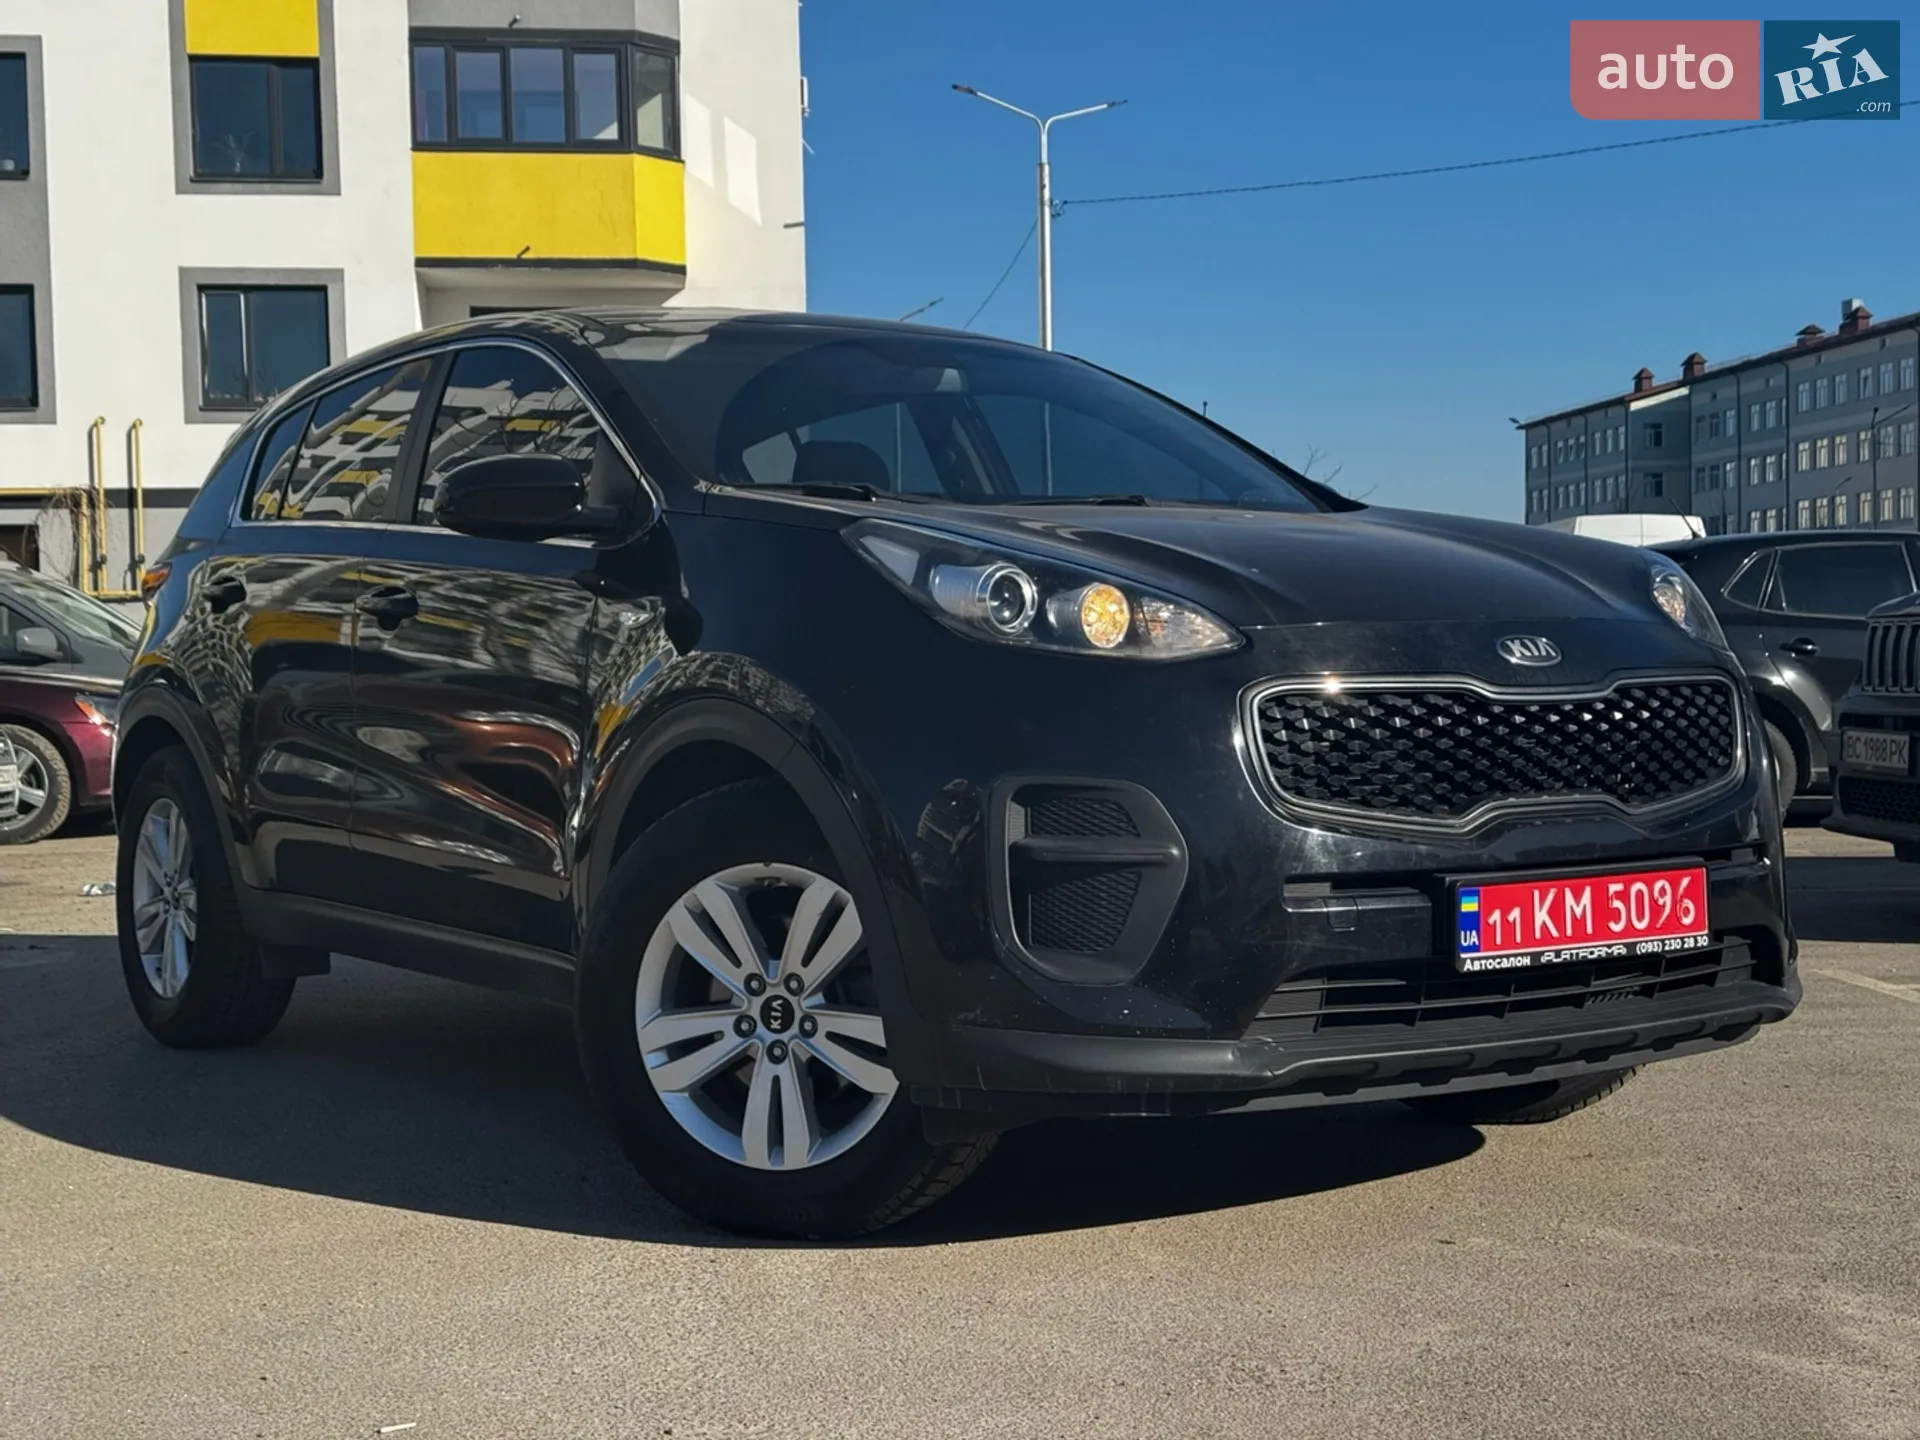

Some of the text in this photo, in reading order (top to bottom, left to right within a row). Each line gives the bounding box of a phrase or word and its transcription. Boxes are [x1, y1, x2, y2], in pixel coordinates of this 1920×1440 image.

[1504, 639, 1556, 657] KIA
[1488, 876, 1696, 945] 11 KM 5096
[1461, 930, 1479, 947] UA
[1463, 955, 1531, 972] Автосалон
[1636, 941, 1663, 955] (093)
[1664, 939, 1682, 951] 230
[1683, 937, 1695, 948] 28
[1696, 935, 1709, 947] 30
[770, 1000, 784, 1029] KIA
